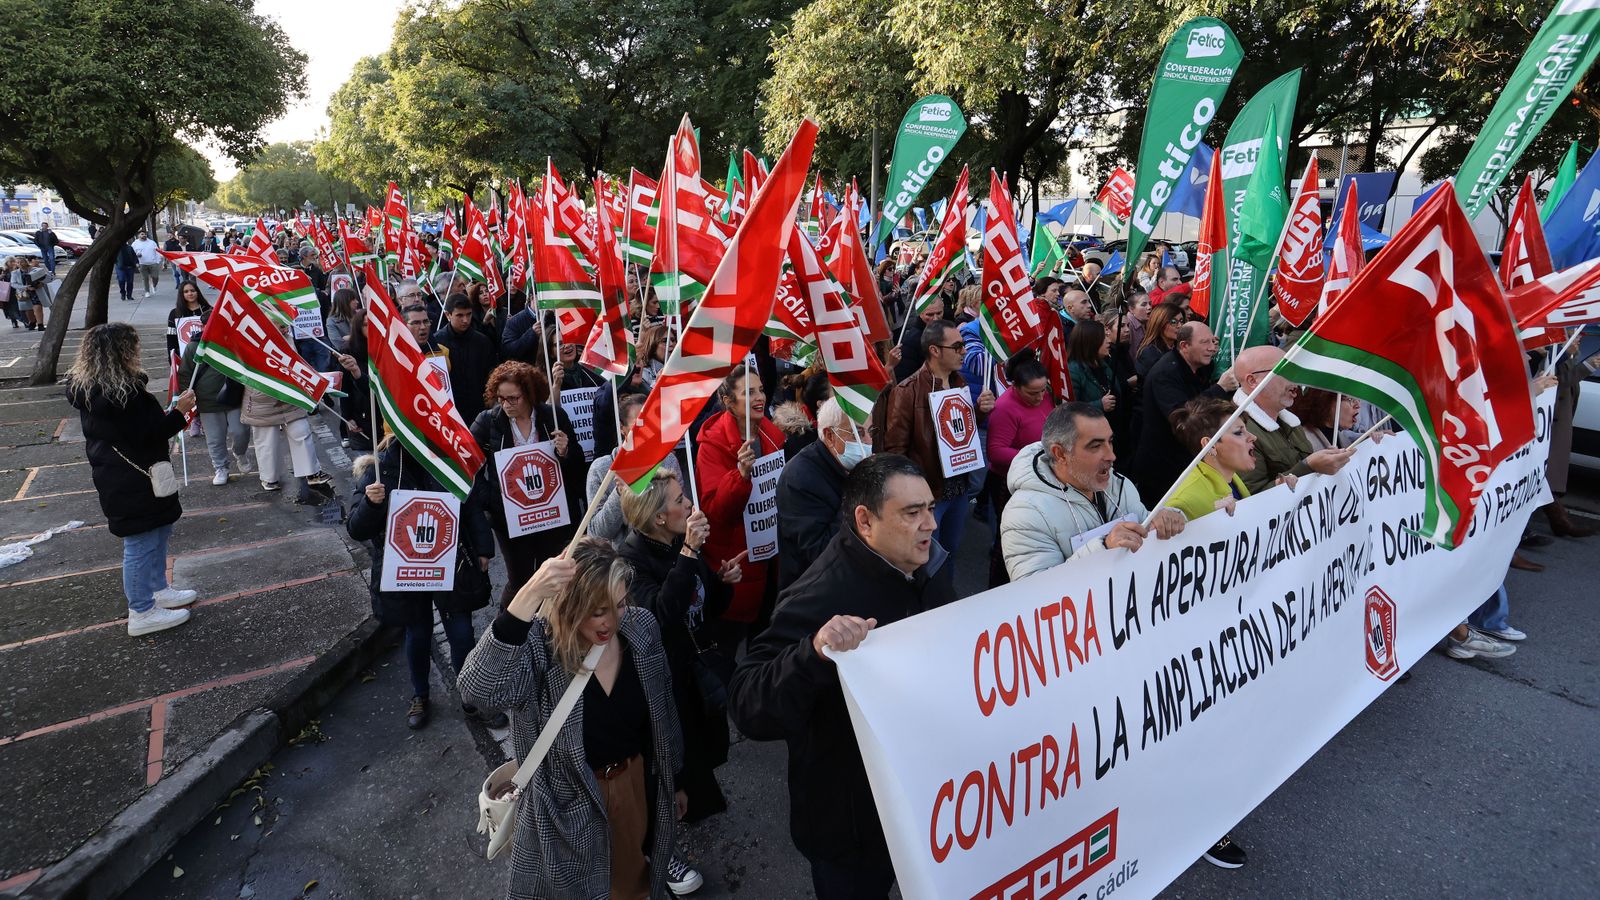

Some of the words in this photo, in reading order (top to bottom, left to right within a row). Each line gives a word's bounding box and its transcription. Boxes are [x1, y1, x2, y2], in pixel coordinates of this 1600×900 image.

[1187, 31, 1226, 50] Fetico
[1165, 61, 1234, 76] CONFEDERACIÓN
[920, 106, 951, 117] Fetico
[1466, 33, 1578, 207] NFEDERACIÓN
[905, 122, 959, 136] CONFEDERACIÓN
[1132, 97, 1216, 235] Fetico
[1223, 147, 1260, 166] Feti
[883, 145, 944, 224] Fetico
[1281, 196, 1321, 266] UGT
[243, 268, 300, 290] Cádiz
[776, 284, 811, 328] ádiz
[988, 279, 1024, 341] Cádiz
[1237, 284, 1251, 337] SINDICAL
[219, 290, 321, 387] CCOO
[561, 391, 597, 404] QUEREM
[413, 393, 472, 466] Cádiz
[952, 418, 964, 433] NO
[752, 456, 784, 478] UEREMOS
[951, 452, 971, 464] CCOO
[1441, 410, 1492, 506] Cád
[525, 474, 543, 491] NO
[748, 495, 777, 515] QUERE
[520, 510, 550, 524] CCOO
[751, 512, 778, 533] CONCI
[415, 526, 435, 543] NO
[399, 568, 433, 578] CCOO
[973, 588, 1102, 717] CONTRA
[1109, 571, 1141, 650] LA
[1151, 526, 1260, 627] APERTURA
[1366, 448, 1425, 502] GRAND
[930, 722, 1081, 864] CONTRA
[1093, 696, 1129, 780] LA
[1141, 595, 1274, 751] AMPLIACIÓN
[1272, 590, 1297, 660] DE
[1301, 581, 1316, 642] LA
[1481, 492, 1492, 532] Y
